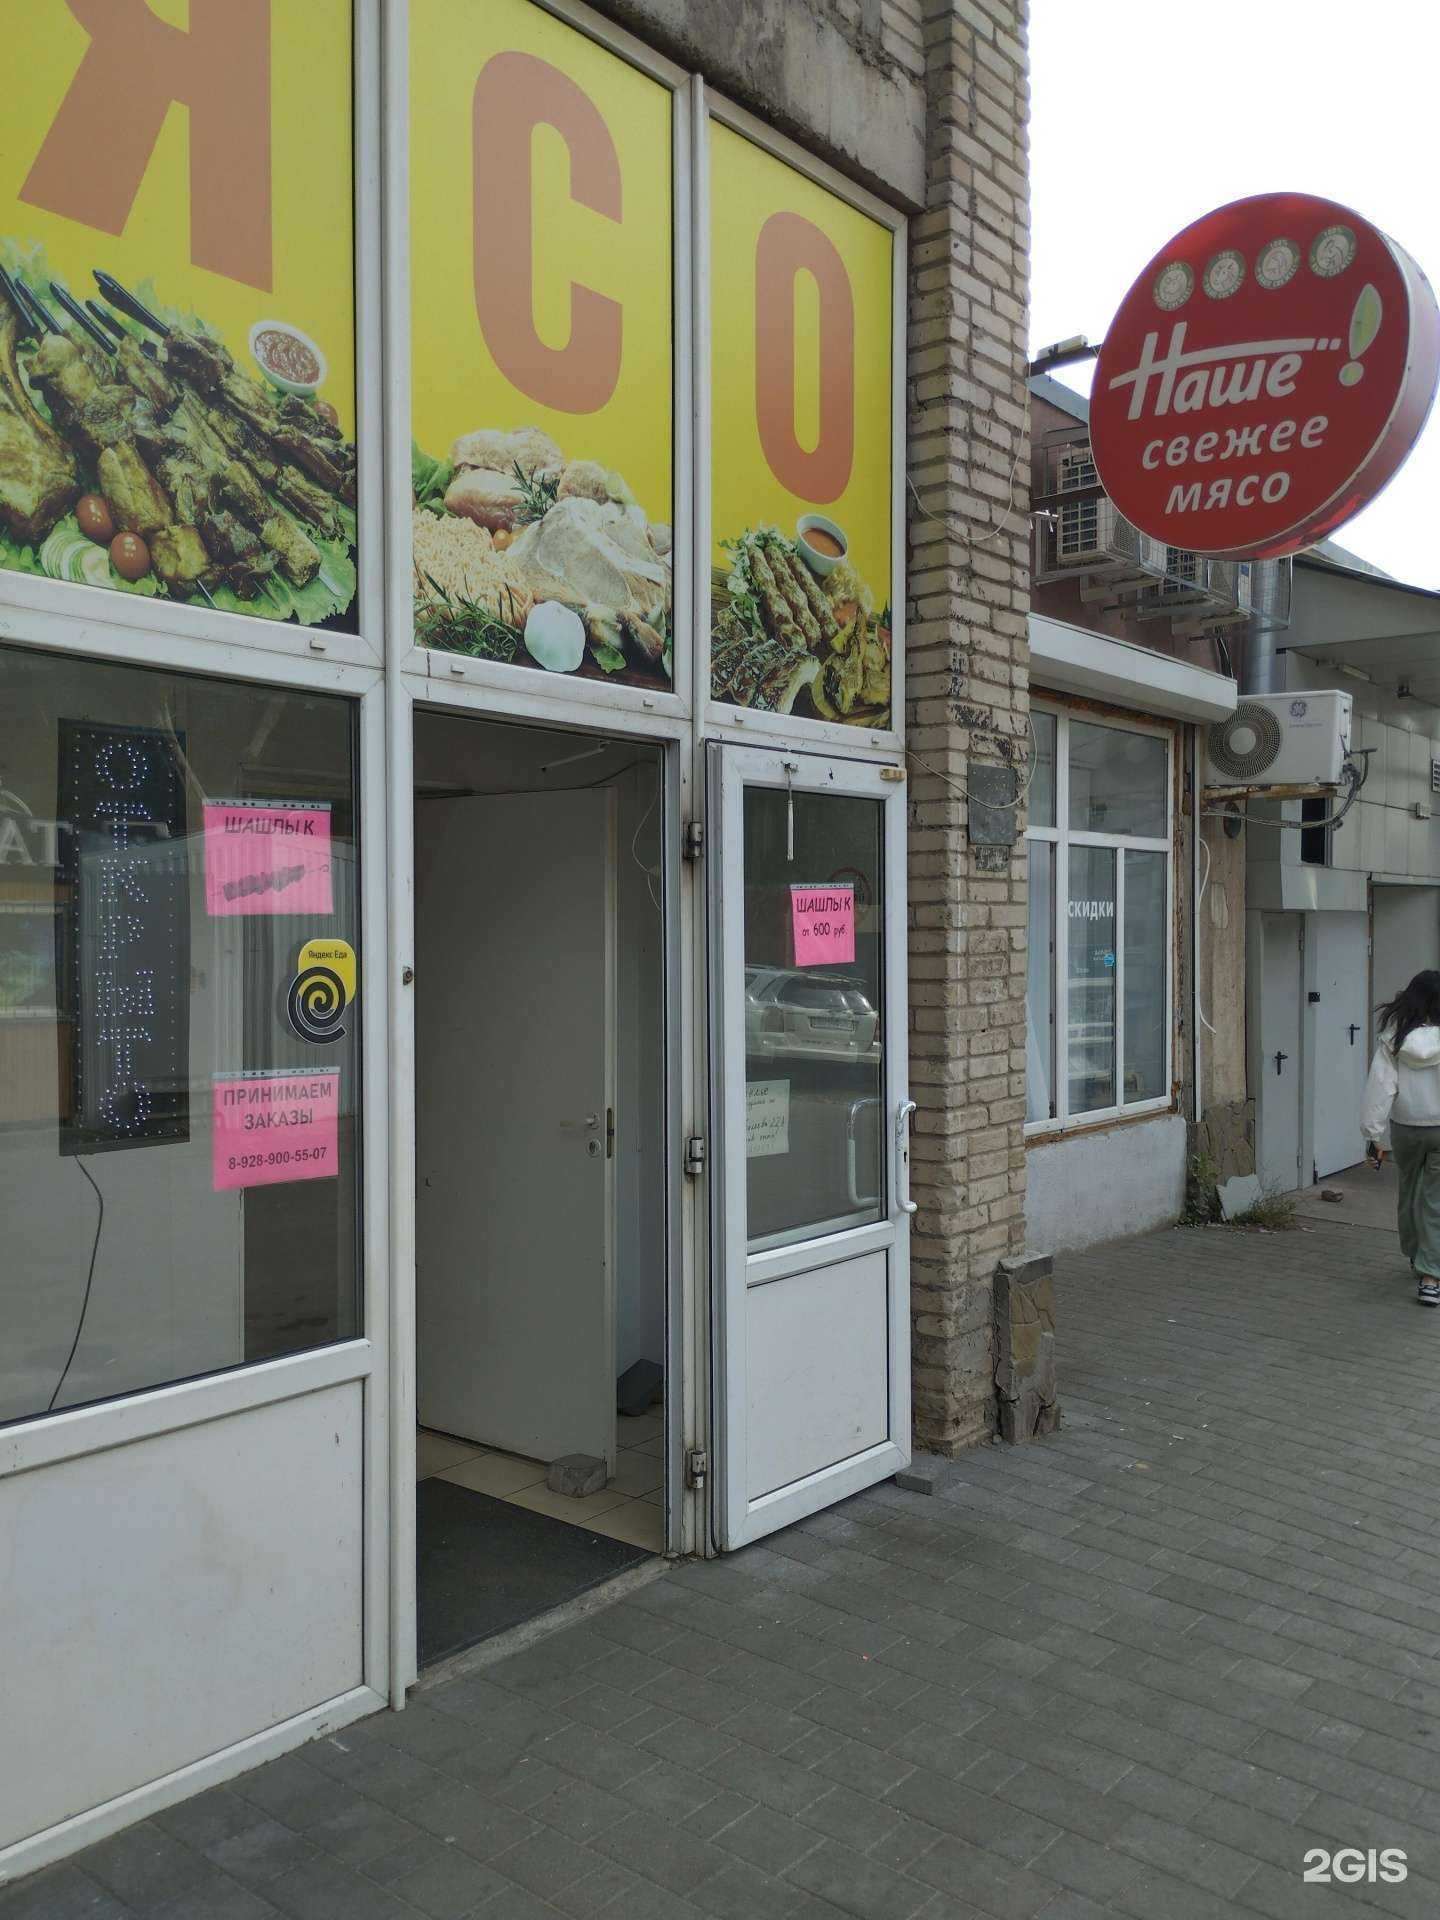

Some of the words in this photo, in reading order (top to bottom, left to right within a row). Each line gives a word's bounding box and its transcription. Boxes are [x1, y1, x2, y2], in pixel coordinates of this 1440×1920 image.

[1142, 415, 1329, 470] свежее
[1165, 471, 1290, 514] мясо
[224, 816, 315, 835] ШАШЛЫК
[796, 896, 851, 913] ШАШЛЫК
[1068, 900, 1114, 920] СКИДКИ
[94, 744, 153, 1128] ОТКРЫТО
[813, 922, 831, 937] 600
[334, 950, 347, 960] Еда
[224, 1082, 331, 1106] ПРИНИМАЕМ
[244, 1108, 313, 1130] ЗАКАЗЫ
[228, 1146, 328, 1170] 8-928-900-55-07
